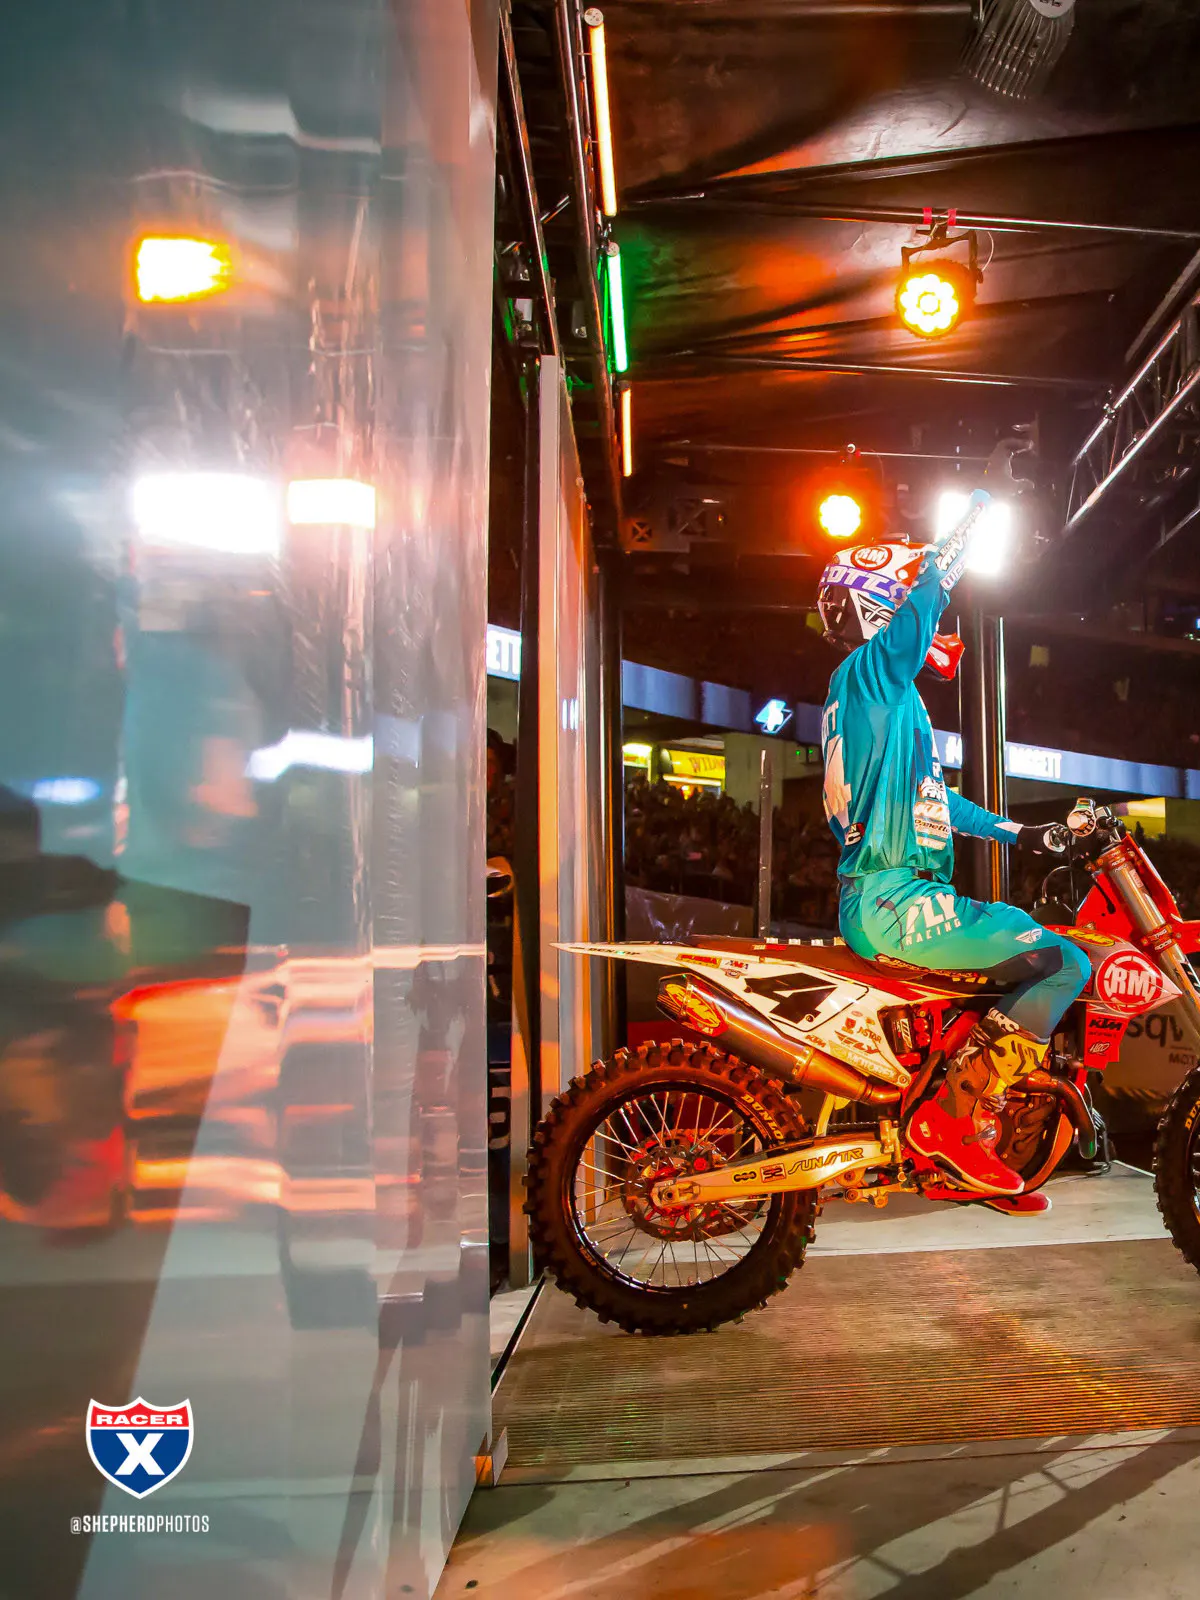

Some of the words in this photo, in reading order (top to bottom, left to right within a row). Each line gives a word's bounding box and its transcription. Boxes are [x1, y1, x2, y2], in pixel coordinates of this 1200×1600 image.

[905, 918, 962, 946] RACING
[743, 972, 839, 1025] 4
[1089, 1018, 1123, 1031] KTM
[740, 1093, 786, 1141] DUNLO
